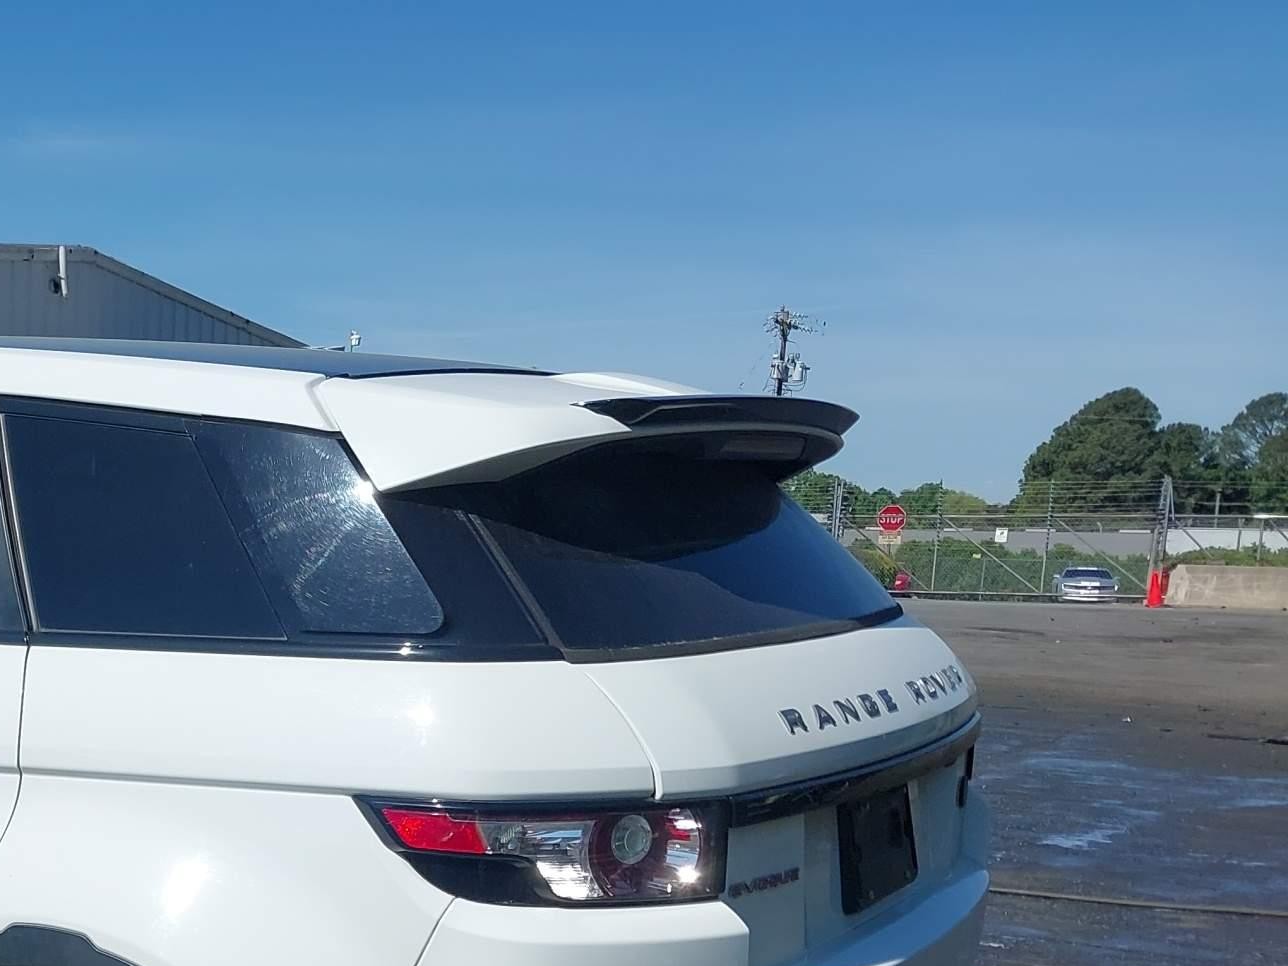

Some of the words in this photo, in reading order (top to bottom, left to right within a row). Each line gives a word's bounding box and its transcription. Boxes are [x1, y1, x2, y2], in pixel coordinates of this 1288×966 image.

[879, 514, 904, 525] STOP
[777, 688, 899, 736] RANGE
[904, 665, 962, 706] ROVER
